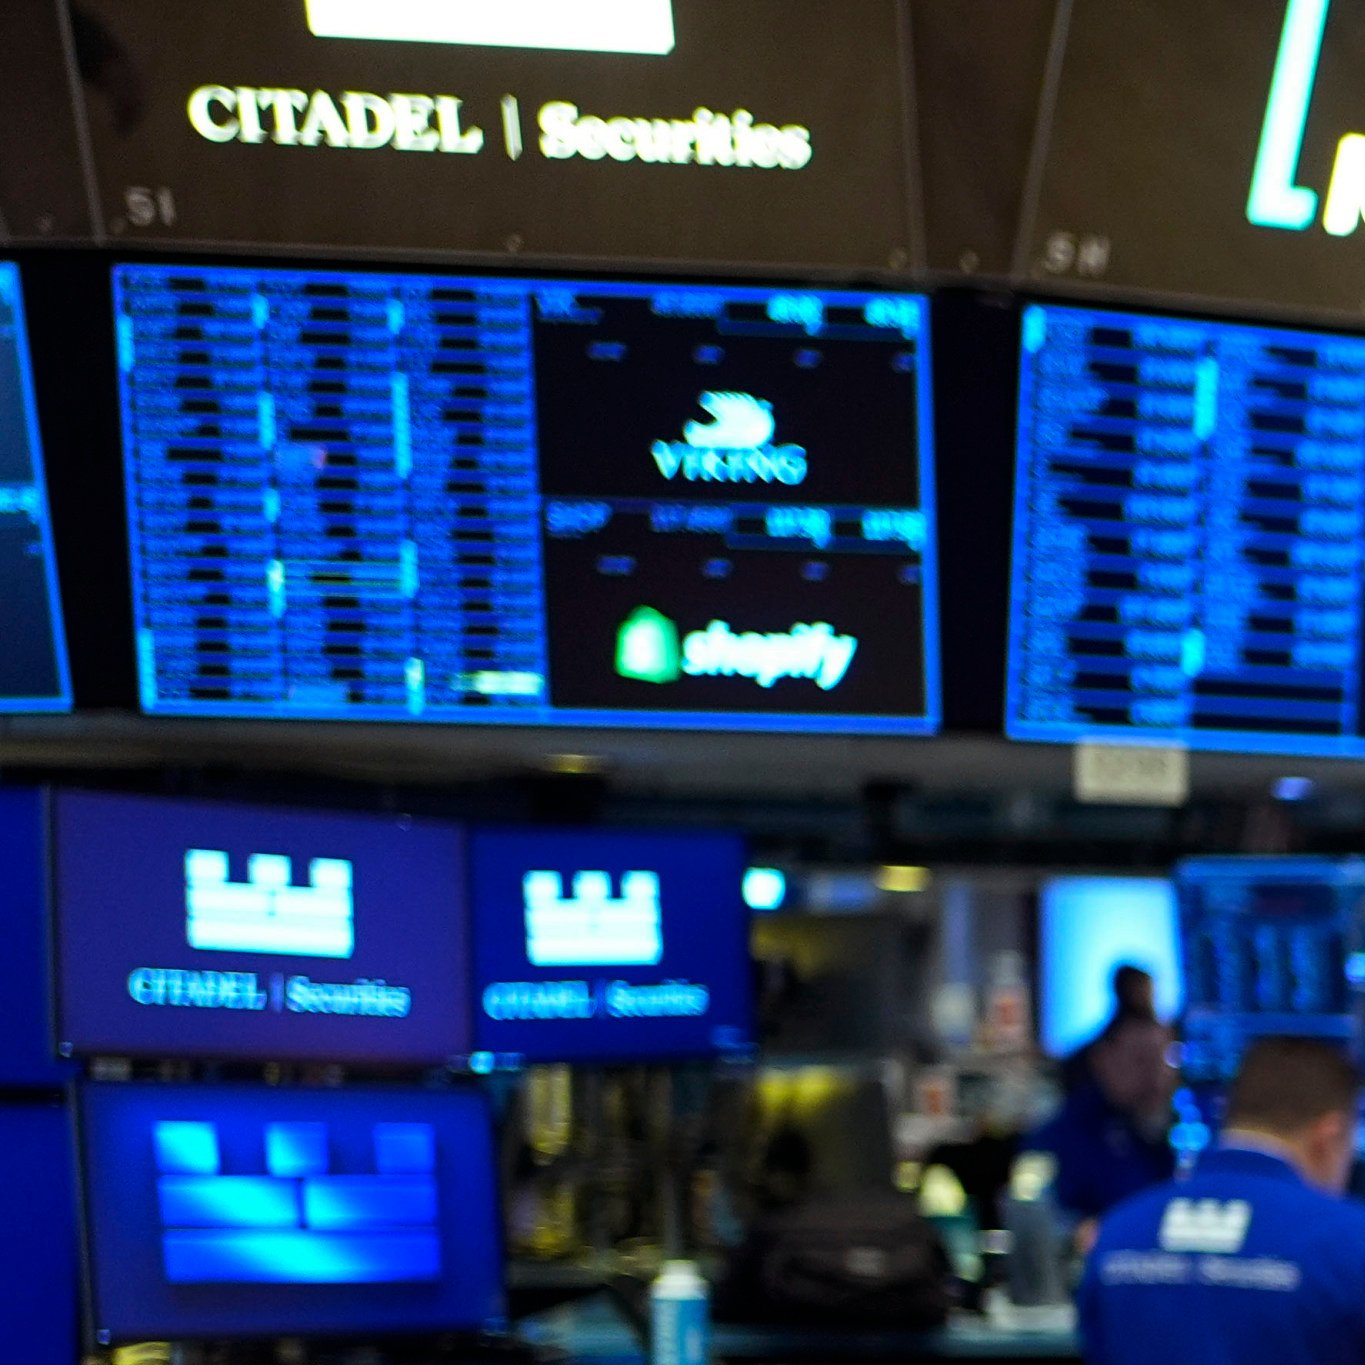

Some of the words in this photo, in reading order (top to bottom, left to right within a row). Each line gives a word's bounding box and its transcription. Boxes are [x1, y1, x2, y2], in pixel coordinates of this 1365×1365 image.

[188, 85, 484, 154] CITADEL
[537, 101, 813, 170] Securities
[650, 438, 808, 485] VIKING
[680, 619, 858, 691] shopify
